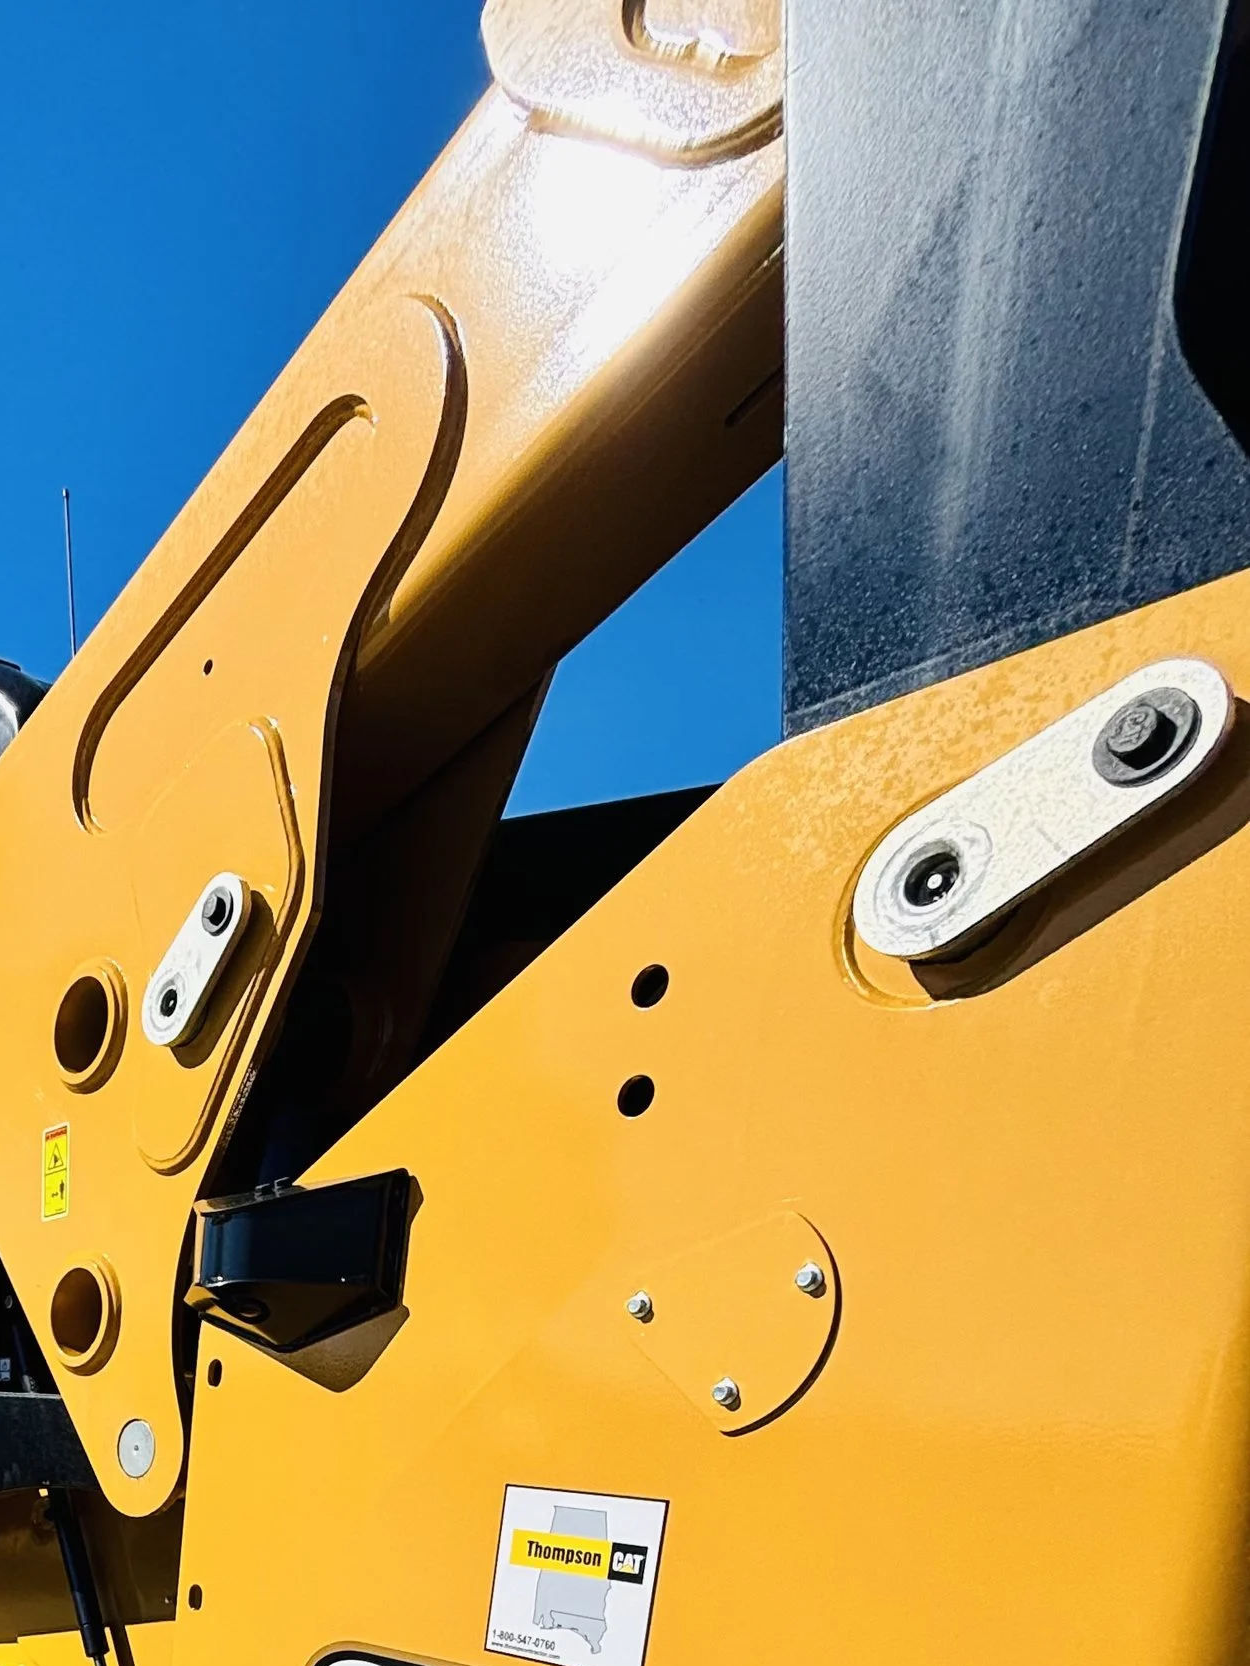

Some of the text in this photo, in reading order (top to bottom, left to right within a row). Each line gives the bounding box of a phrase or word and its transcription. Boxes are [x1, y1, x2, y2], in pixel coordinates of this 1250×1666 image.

[527, 1540, 646, 1575] Thompson CAT
[492, 1629, 556, 1652] 1-800-547-0760
